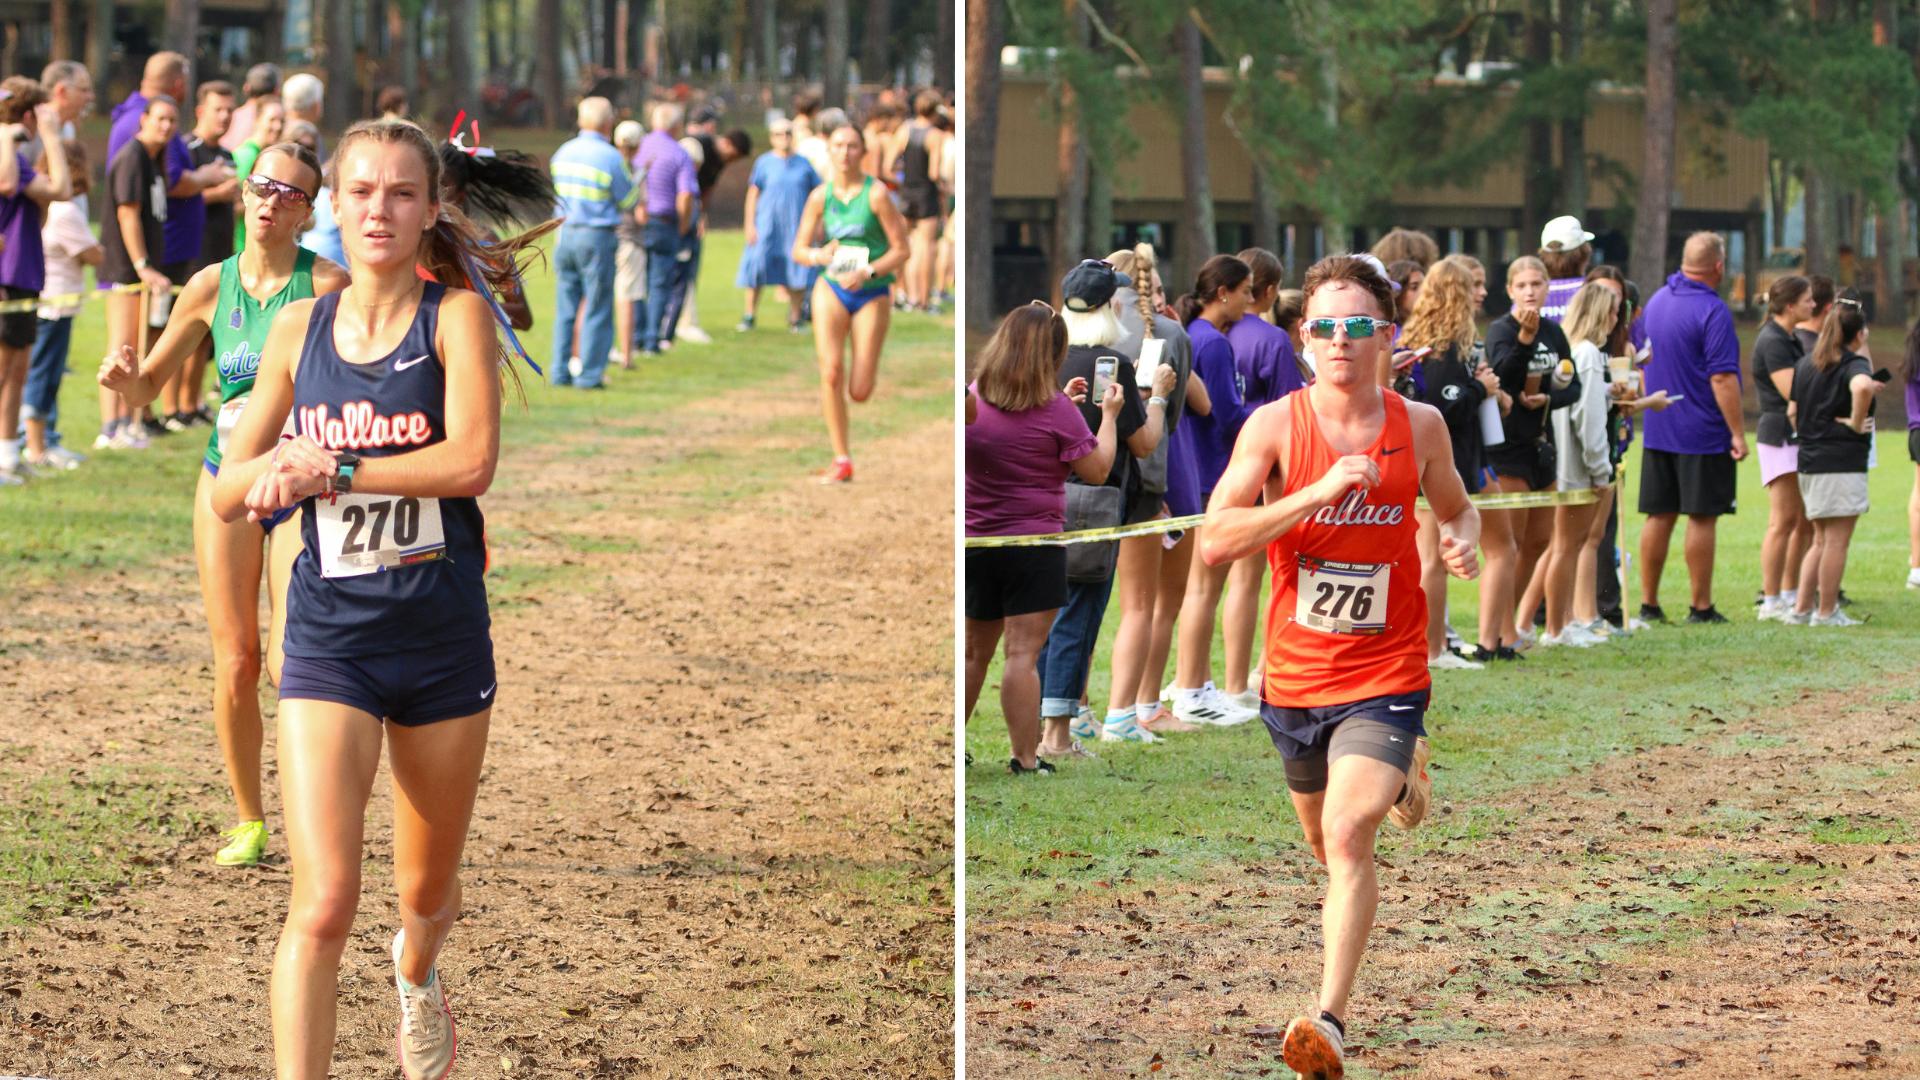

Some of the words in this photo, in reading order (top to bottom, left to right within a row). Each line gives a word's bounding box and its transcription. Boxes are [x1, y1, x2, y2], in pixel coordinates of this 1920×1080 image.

[300, 401, 432, 450] Wallace
[341, 497, 420, 556] 270
[1303, 488, 1404, 526] allace
[1310, 581, 1375, 621] 276
